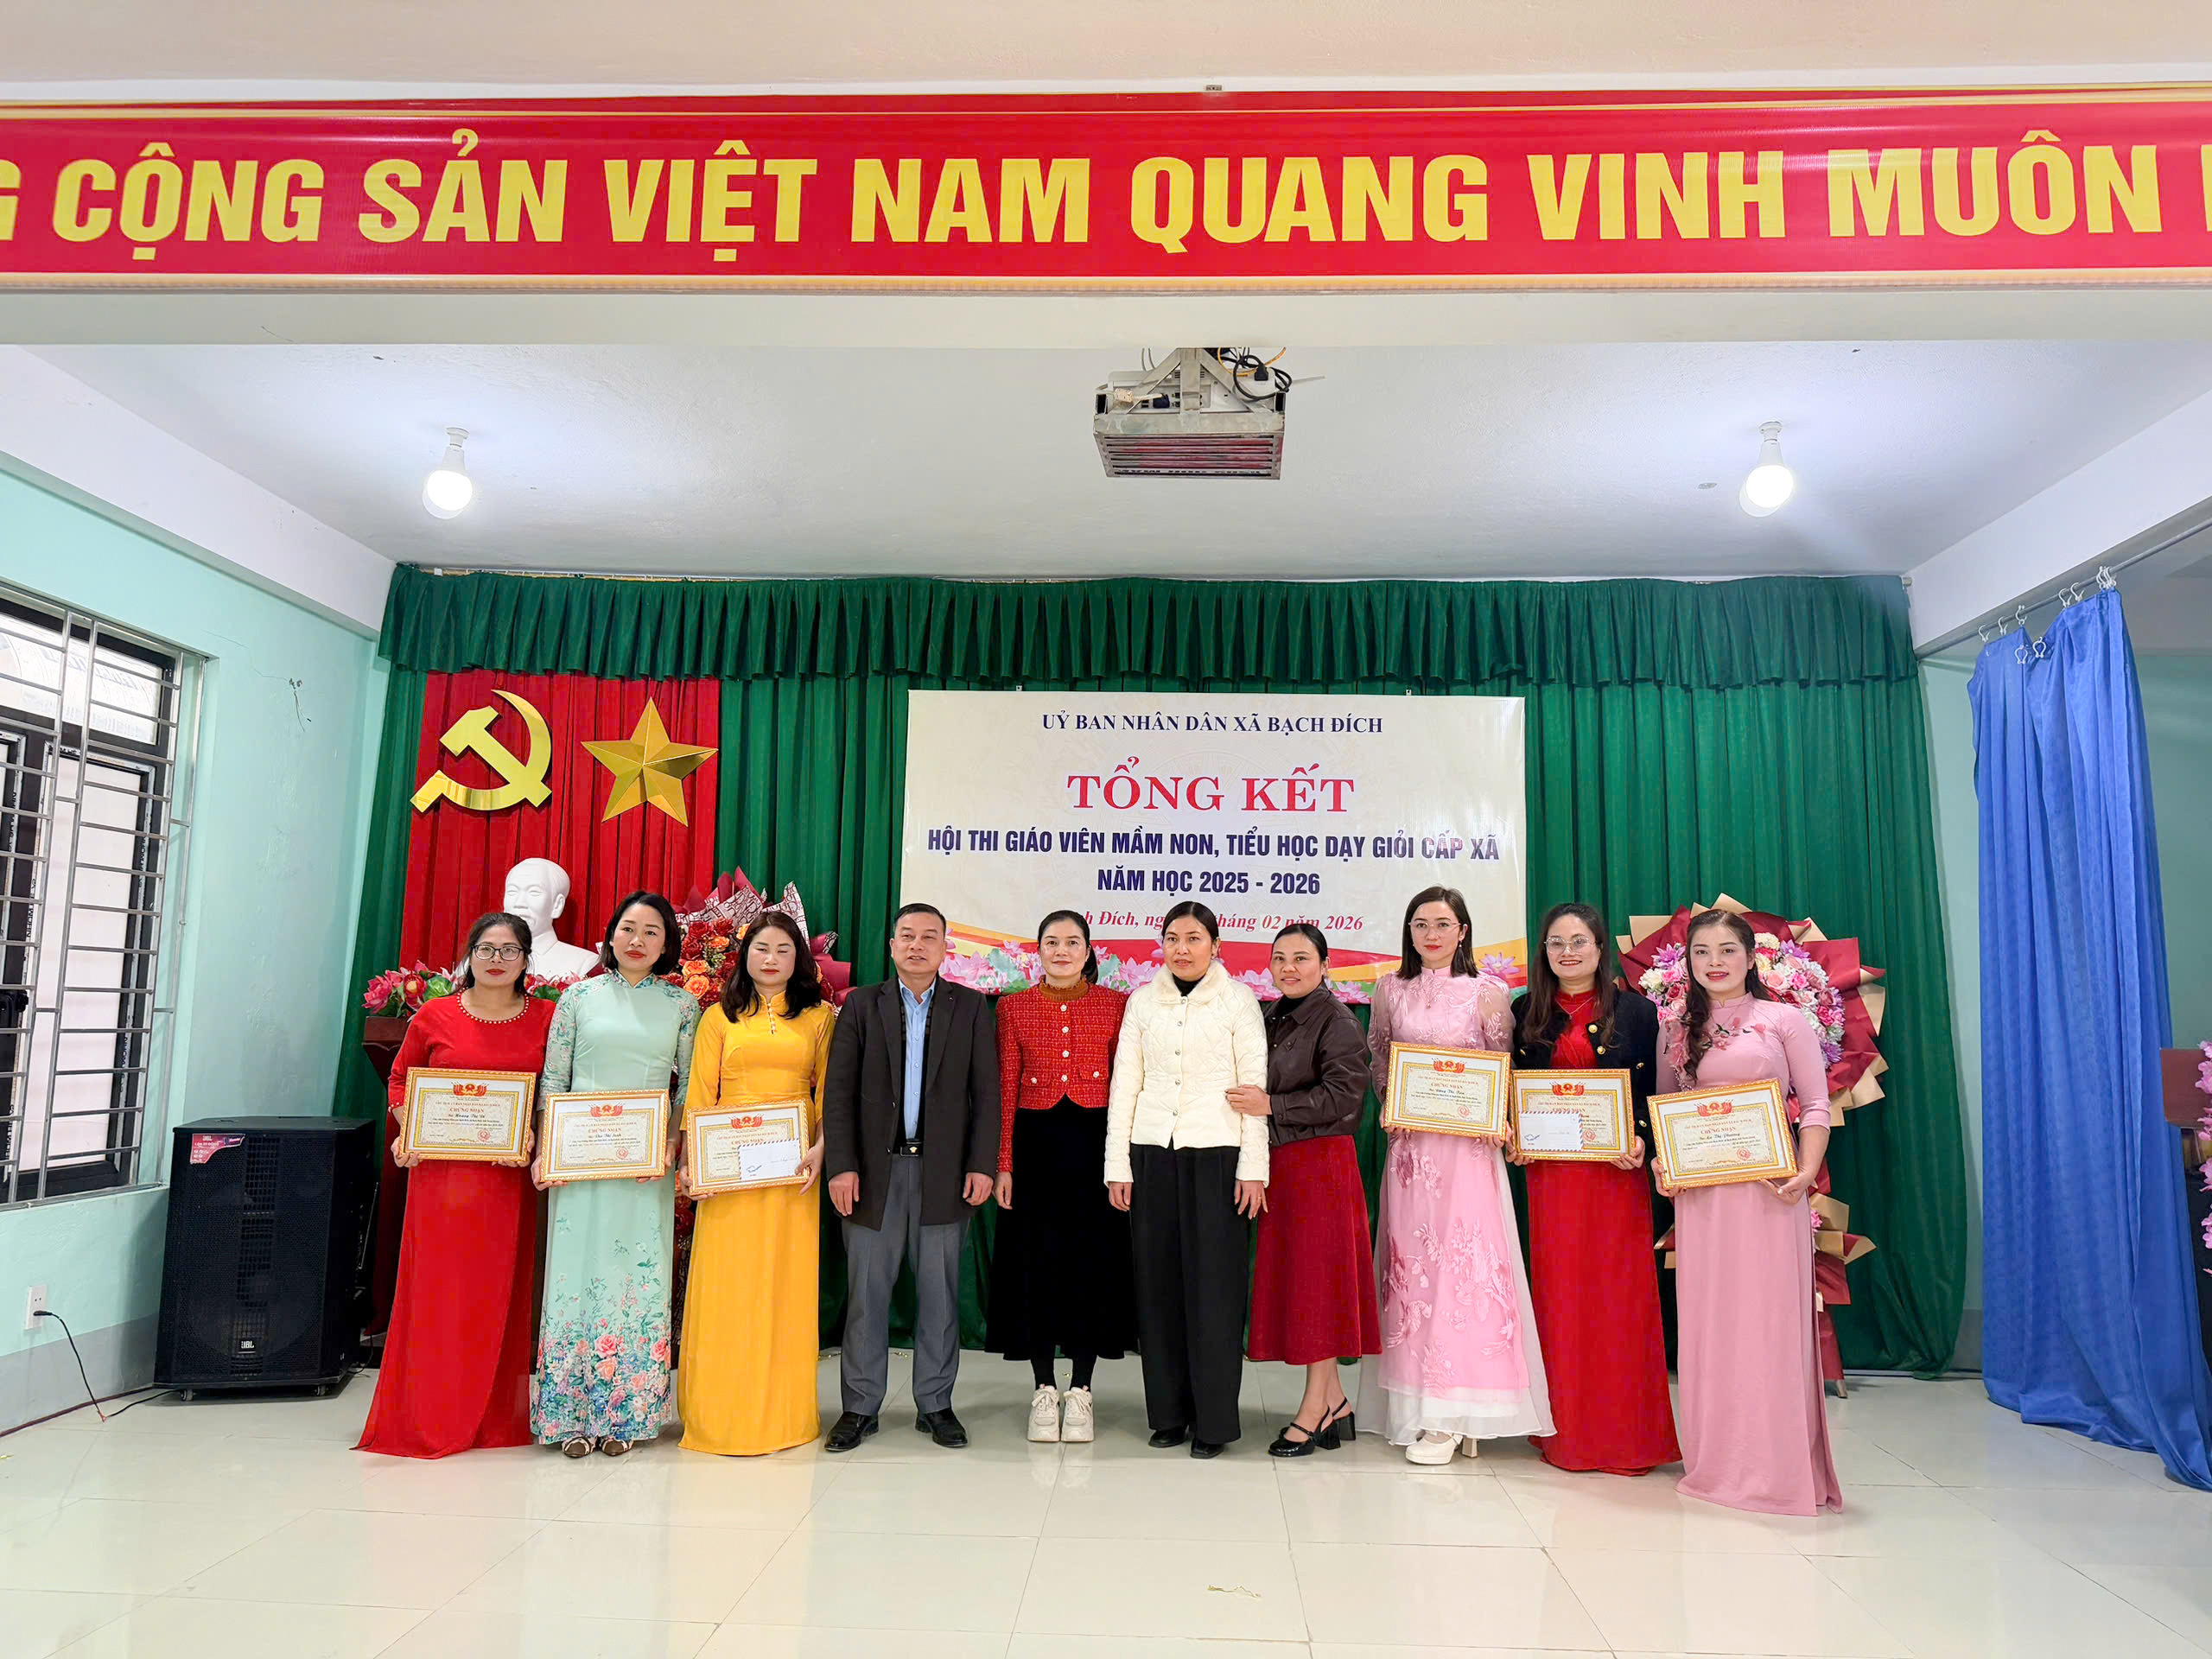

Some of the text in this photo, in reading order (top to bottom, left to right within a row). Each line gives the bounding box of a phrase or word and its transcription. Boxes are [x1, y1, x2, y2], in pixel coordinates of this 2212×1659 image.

[53, 142, 324, 260] CỘNG
[359, 128, 568, 243] SẢN
[604, 139, 817, 262] VIỆT
[851, 158, 1090, 243] NAM
[1130, 156, 1488, 254] QUANG
[1528, 151, 1786, 240] VINH
[1827, 130, 2162, 238] MUÔN
[1042, 709, 1383, 736] UỶ BAN NHÂN DÂN XÃ BẠCH ĐÍCH
[1067, 756, 1355, 812] TỔNG KẾT
[927, 825, 1500, 862] HỘI THI GIÁO VIÊN MẦM NON, TIỂU HỌC DẠY GIỎI CẤP XÃ
[1098, 864, 1145, 892] NĂM
[1152, 870, 1192, 897] HỌC
[1198, 871, 1249, 893] 2025
[1269, 873, 1320, 895] 2026
[1098, 911, 1140, 929] Đích,
[1262, 915, 1282, 931] 02
[1325, 915, 1363, 931] 2026
[240, 1340, 256, 1350] JBL
